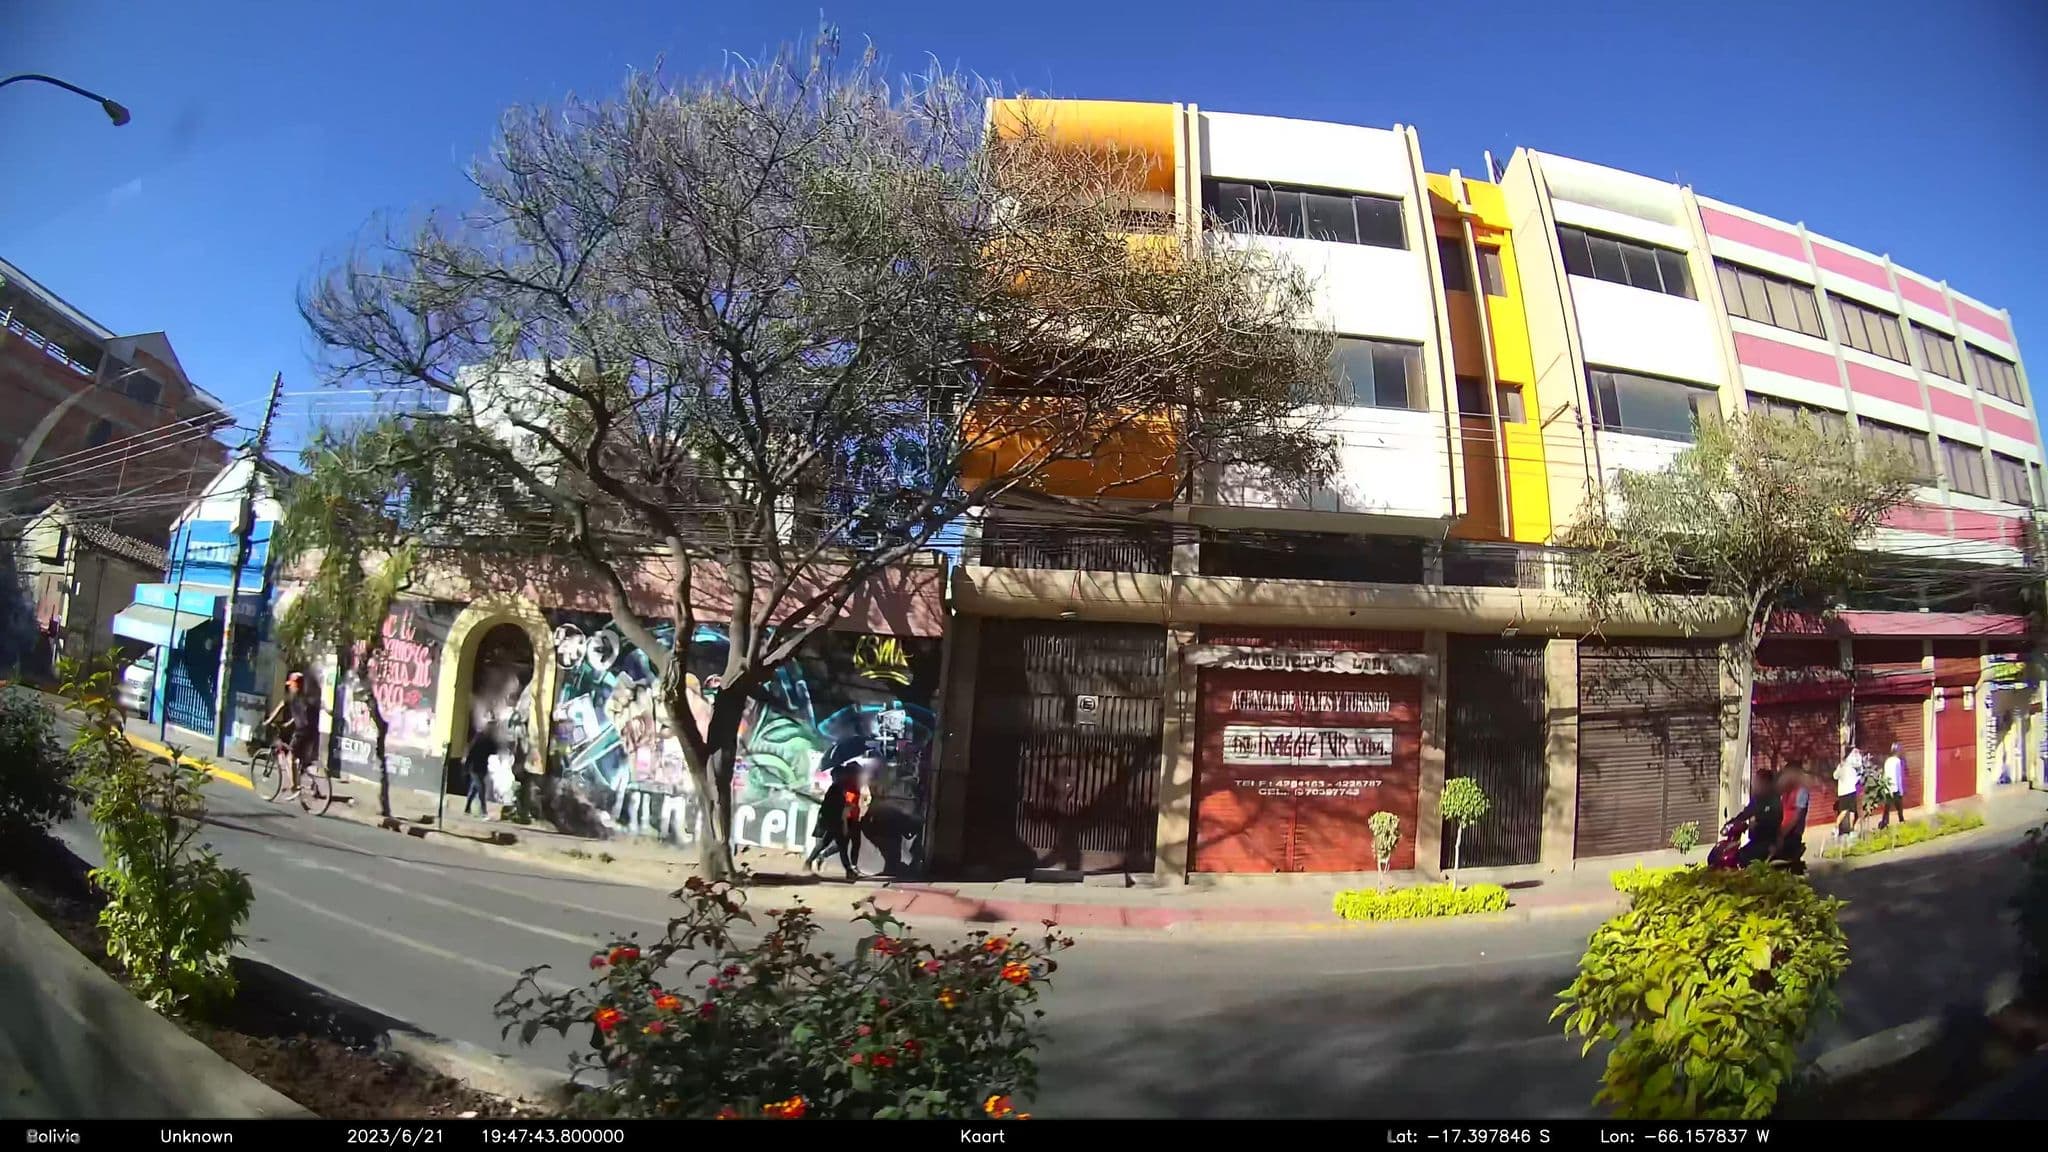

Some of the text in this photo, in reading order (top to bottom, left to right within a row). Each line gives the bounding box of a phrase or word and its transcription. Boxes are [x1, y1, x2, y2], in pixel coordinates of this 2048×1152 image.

[1230, 690, 1390, 713] AGENCIA DE VIAJES Y TURISMO
